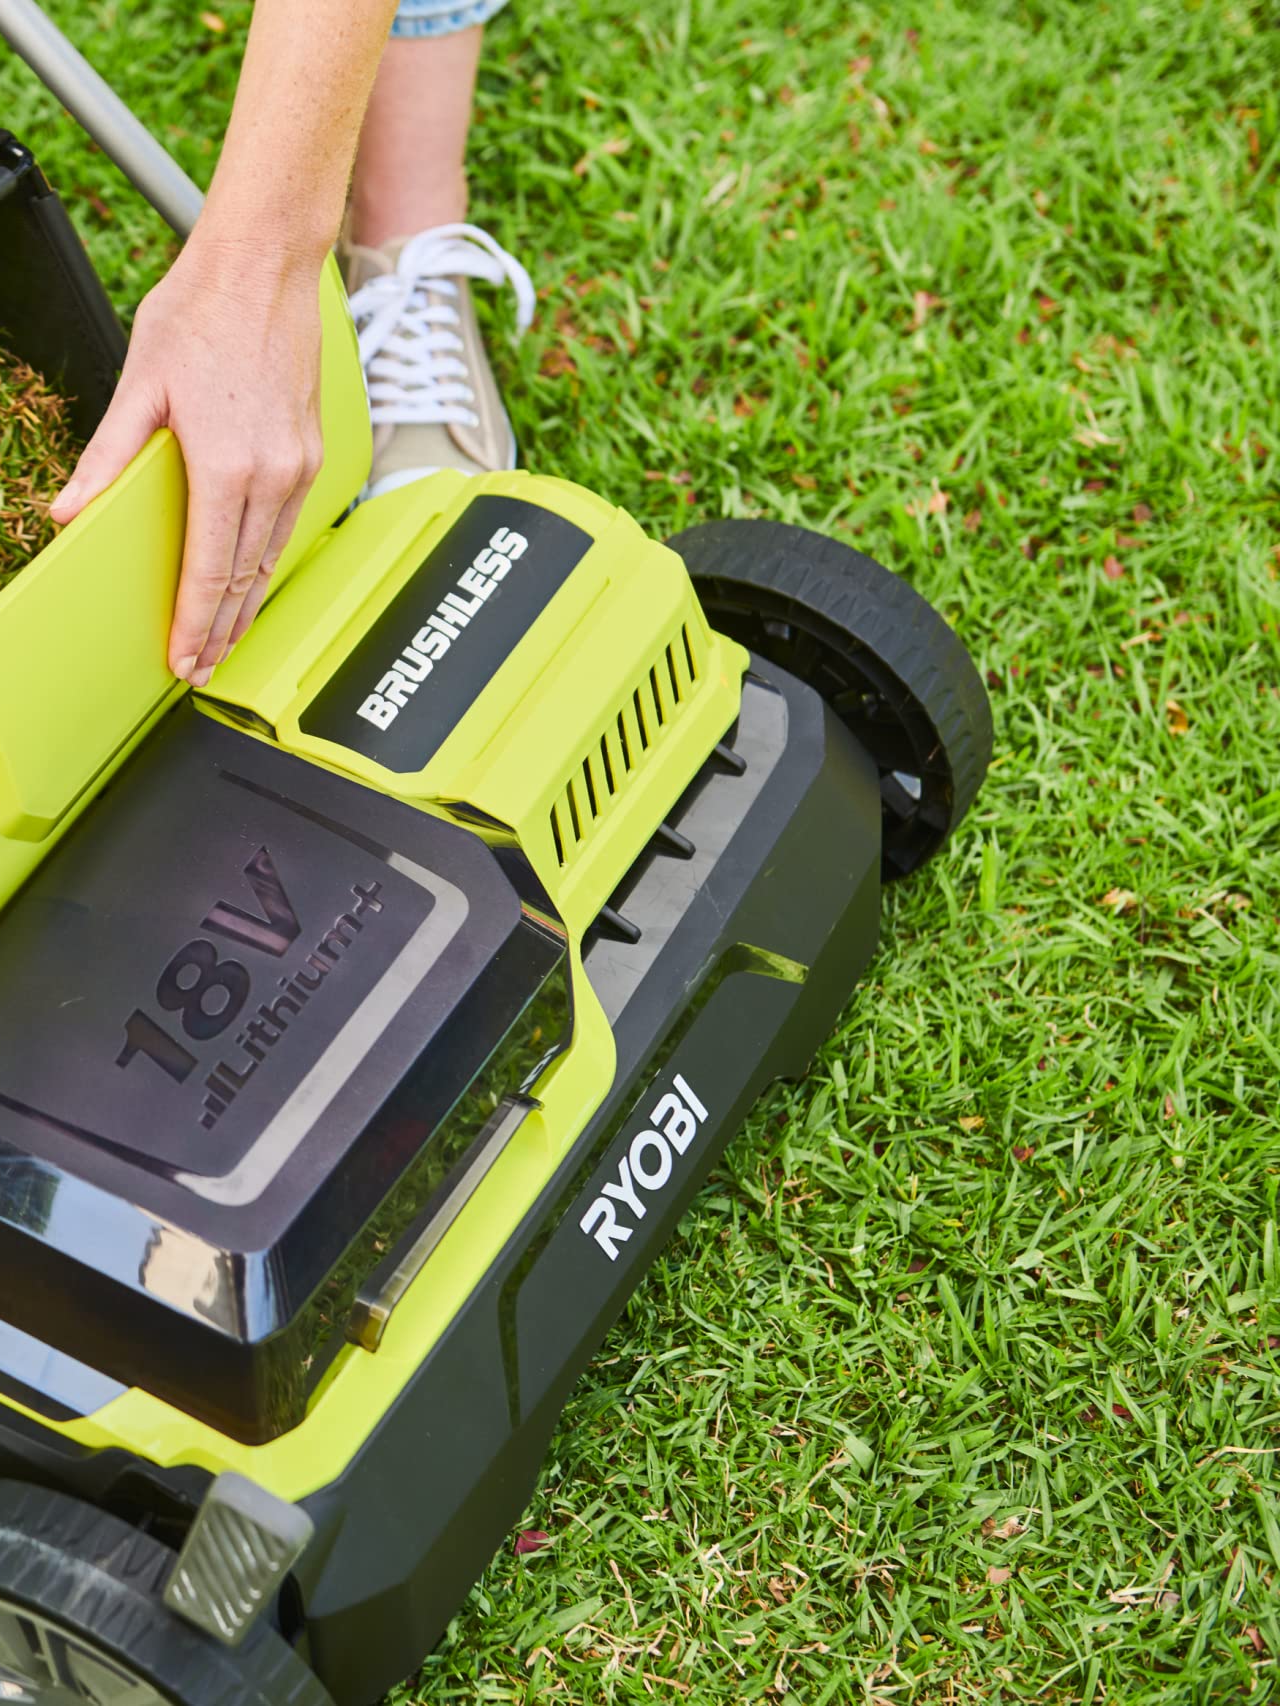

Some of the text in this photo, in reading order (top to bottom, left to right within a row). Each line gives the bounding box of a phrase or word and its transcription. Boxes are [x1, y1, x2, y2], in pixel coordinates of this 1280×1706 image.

[356, 527, 529, 731] BRUSHLESS
[115, 845, 302, 1085] 18V
[579, 1073, 709, 1262] RYOBI
